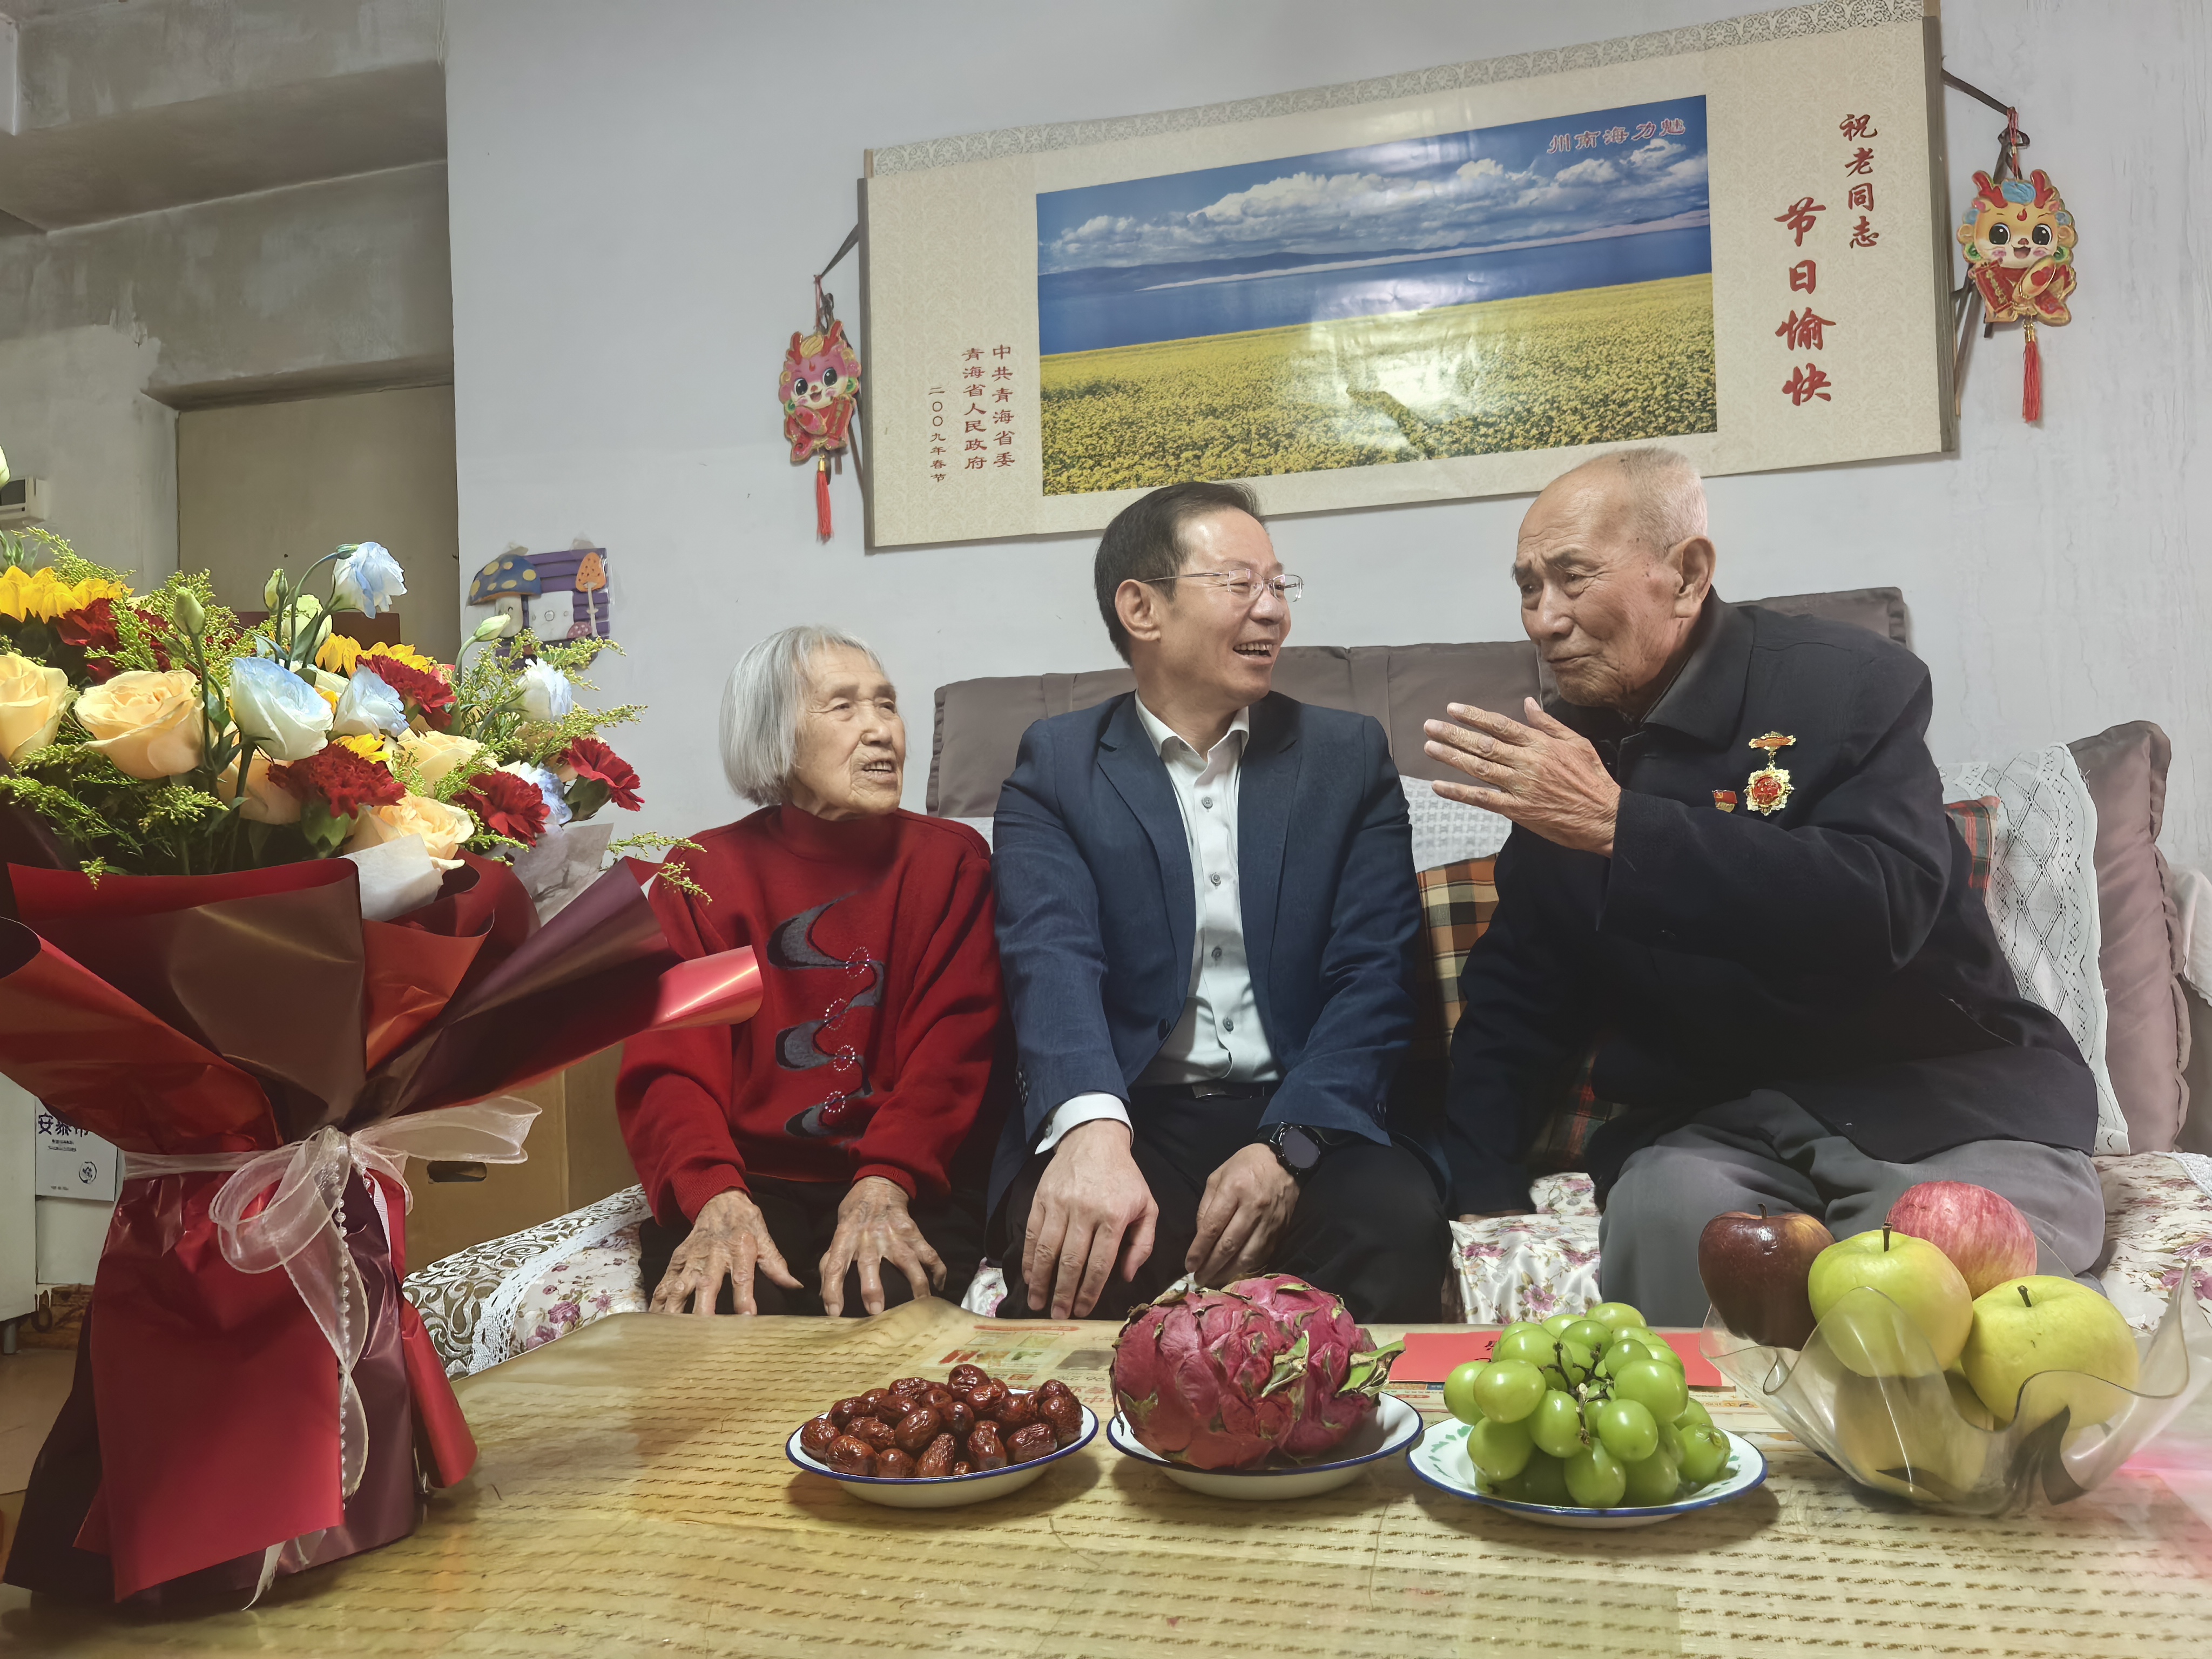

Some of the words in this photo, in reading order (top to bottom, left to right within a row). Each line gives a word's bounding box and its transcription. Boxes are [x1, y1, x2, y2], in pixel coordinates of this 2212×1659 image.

[1839, 114, 1879, 248] 祝老同志
[1774, 197, 1837, 406] 节日愉快
[961, 348, 988, 469] 青海省人民政府
[992, 344, 1015, 468] 中共青海省委
